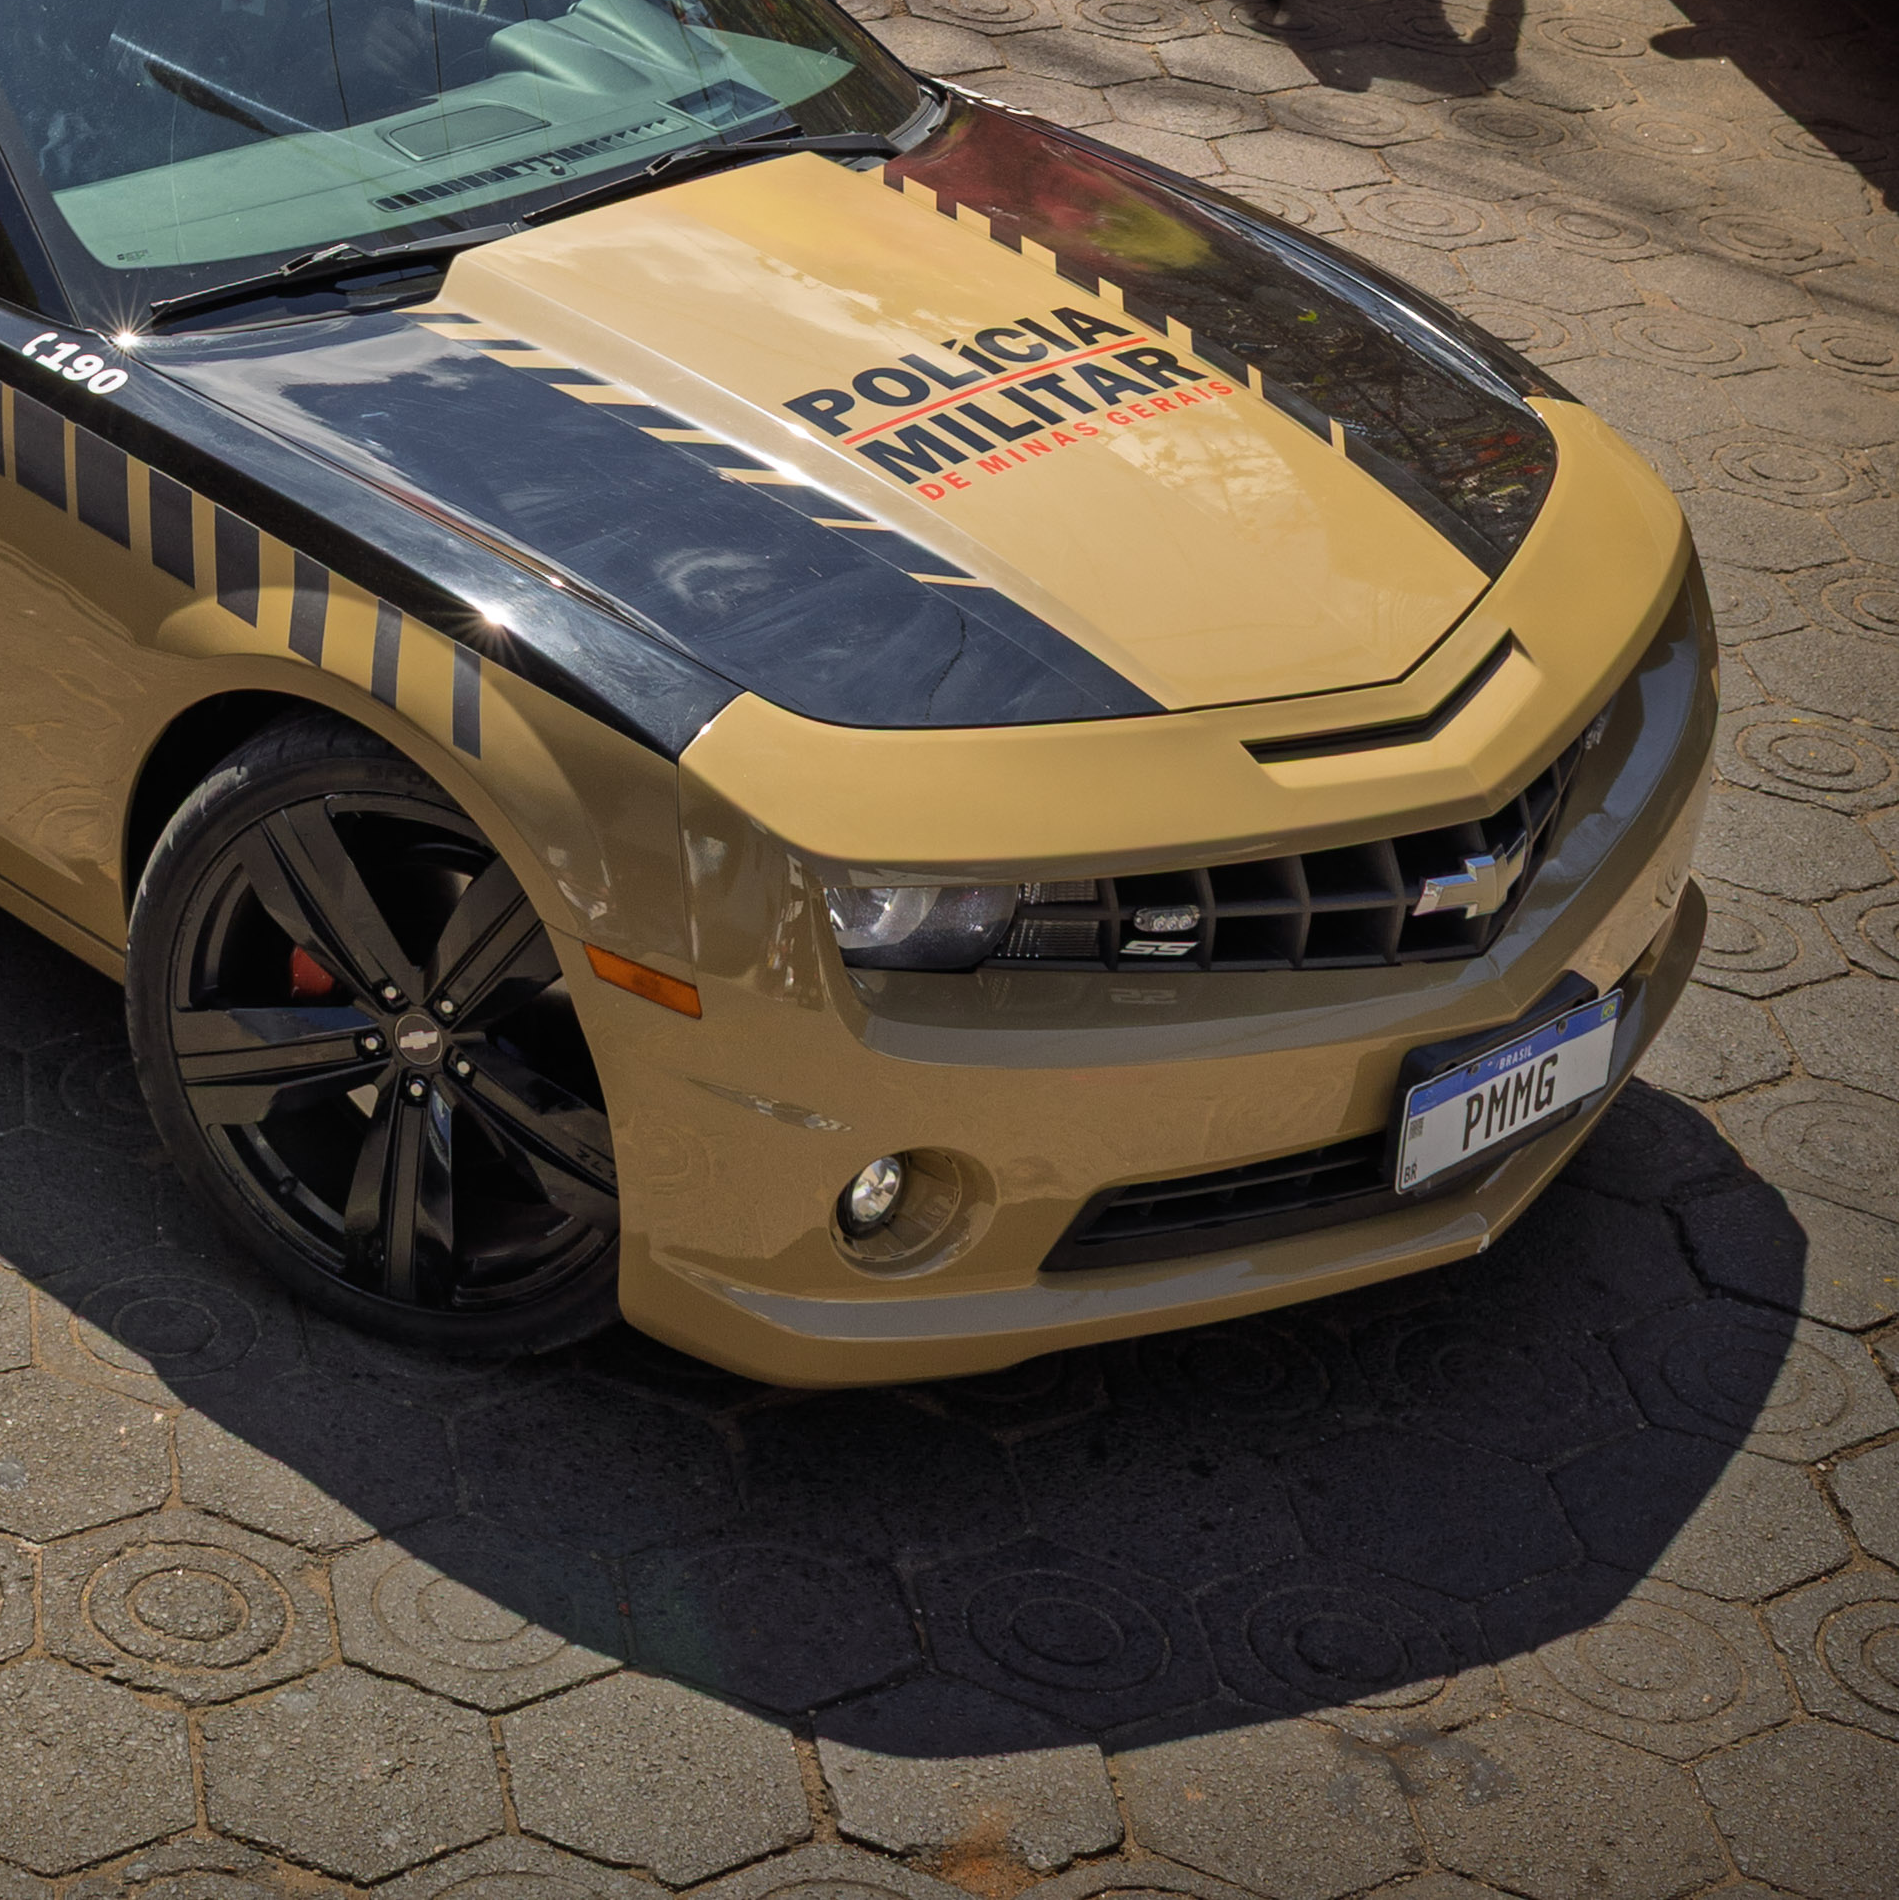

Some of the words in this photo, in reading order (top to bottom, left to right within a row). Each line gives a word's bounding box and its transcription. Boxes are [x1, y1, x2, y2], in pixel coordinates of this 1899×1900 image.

[34, 341, 129, 395] 190
[854, 346, 1210, 486] MILITAR
[916, 471, 973, 502] DE
[975, 420, 1100, 476] MINAS
[1105, 380, 1235, 427] GERAIS
[1119, 940, 1199, 957] SS
[1499, 1045, 1533, 1070] BRASIL
[1462, 1052, 1559, 1152] PMMG
[1403, 1162, 1418, 1184] BR
